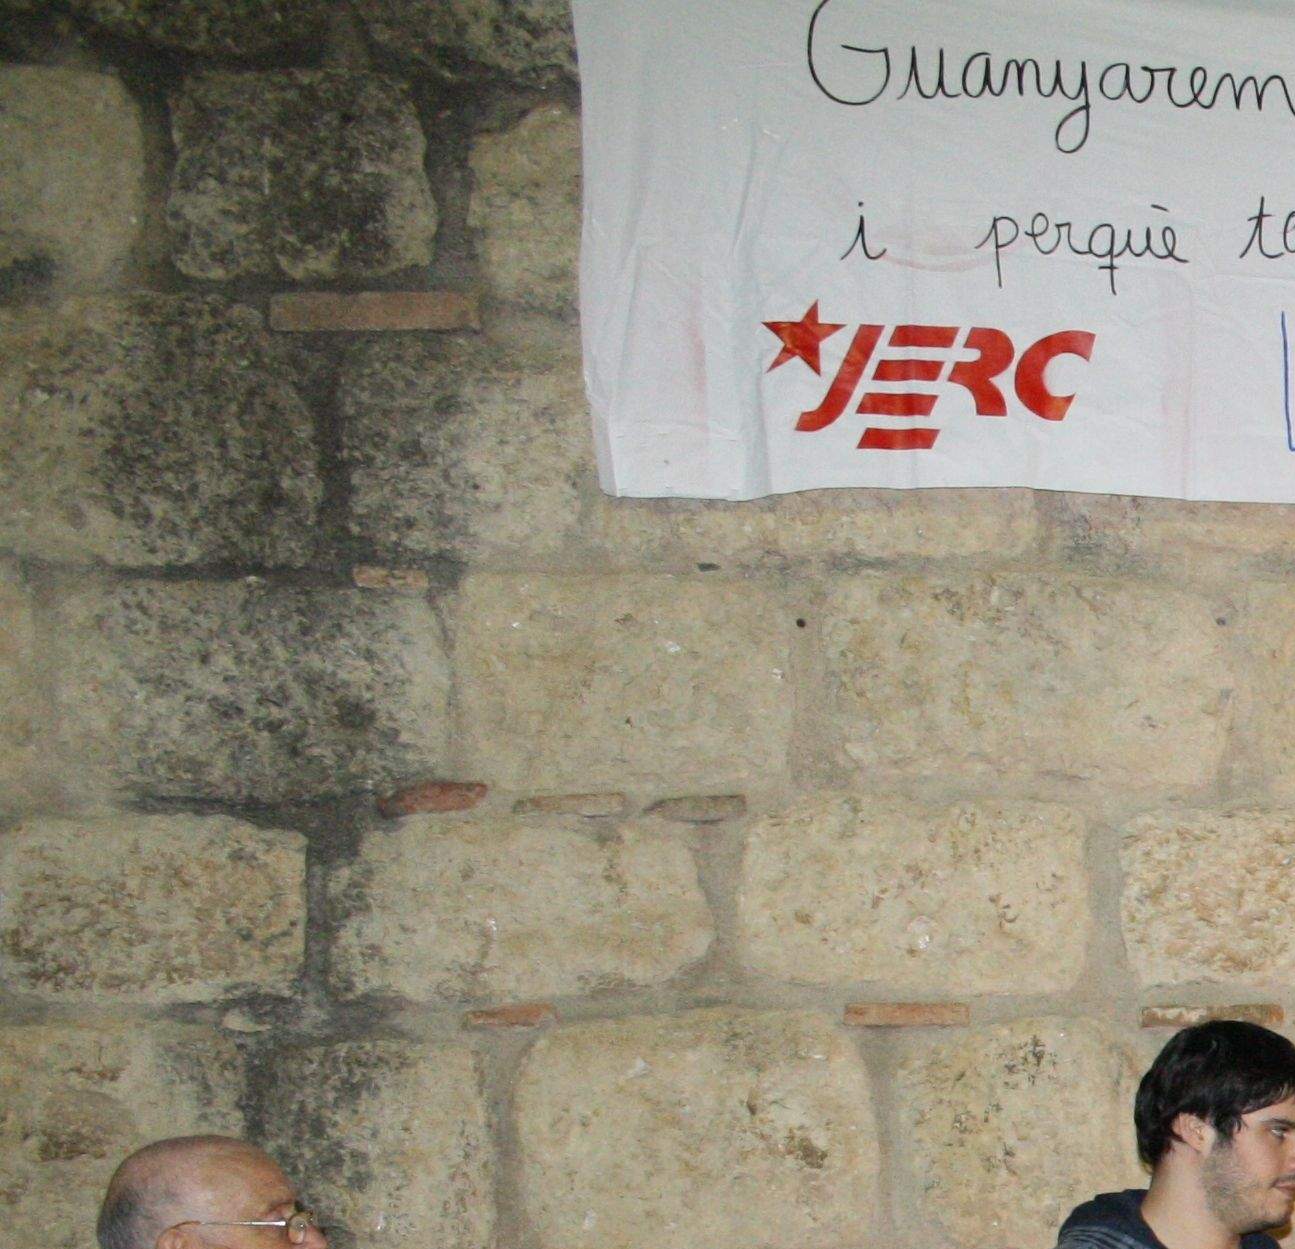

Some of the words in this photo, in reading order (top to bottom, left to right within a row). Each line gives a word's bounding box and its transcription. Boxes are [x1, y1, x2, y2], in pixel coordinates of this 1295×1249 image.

[841, 202, 887, 260] i
[975, 204, 1189, 295] perquè
[796, 325, 1096, 449] JERC
